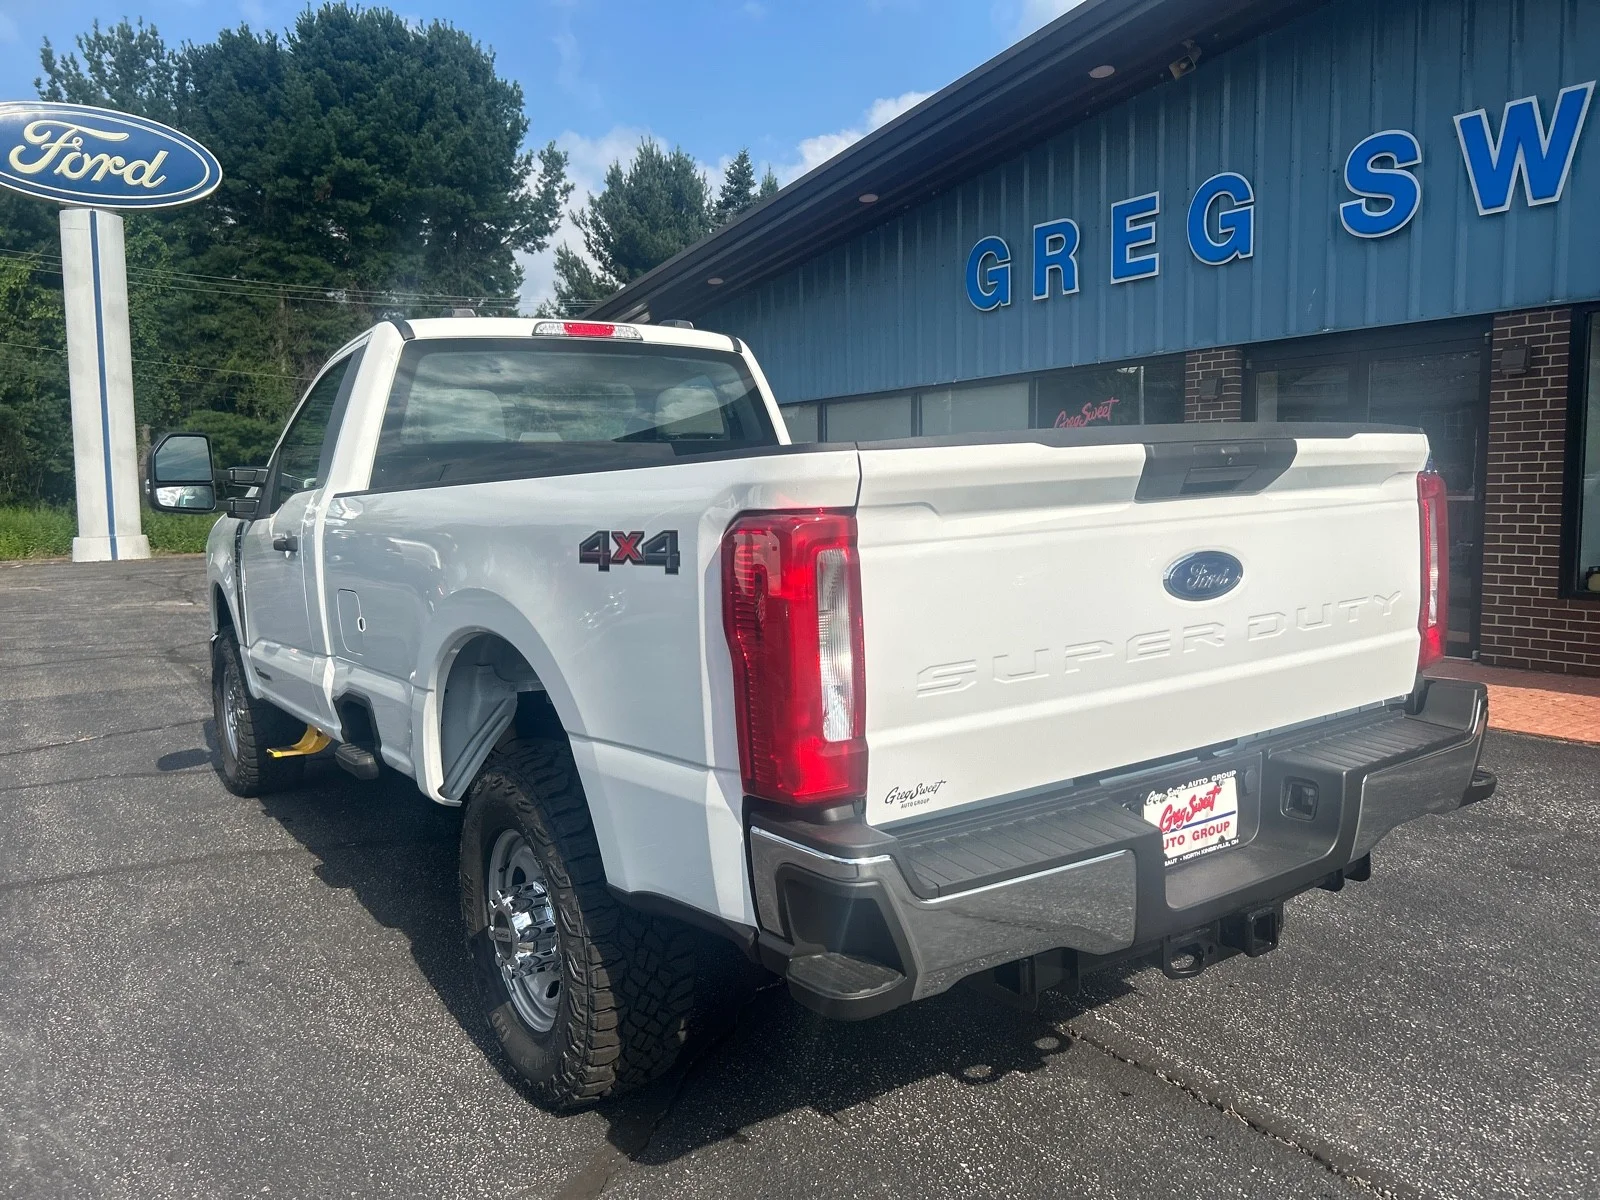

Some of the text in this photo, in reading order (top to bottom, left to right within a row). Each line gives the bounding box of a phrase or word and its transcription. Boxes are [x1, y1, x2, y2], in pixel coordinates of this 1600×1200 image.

[9, 119, 169, 188] Ford
[965, 80, 1598, 312] GREG SW
[1079, 396, 1120, 428] Sweet
[1186, 563, 1230, 590] Ford
[917, 590, 1402, 697] SUPER DUTY
[884, 779, 947, 804] Greg Sweet
[1187, 778, 1208, 789] AUTO
[1211, 770, 1237, 782] GROUP
[901, 798, 930, 809] AUTO GROUP
[1160, 785, 1222, 833] Greg Sweet
[1164, 821, 1230, 850] UTO GROUP
